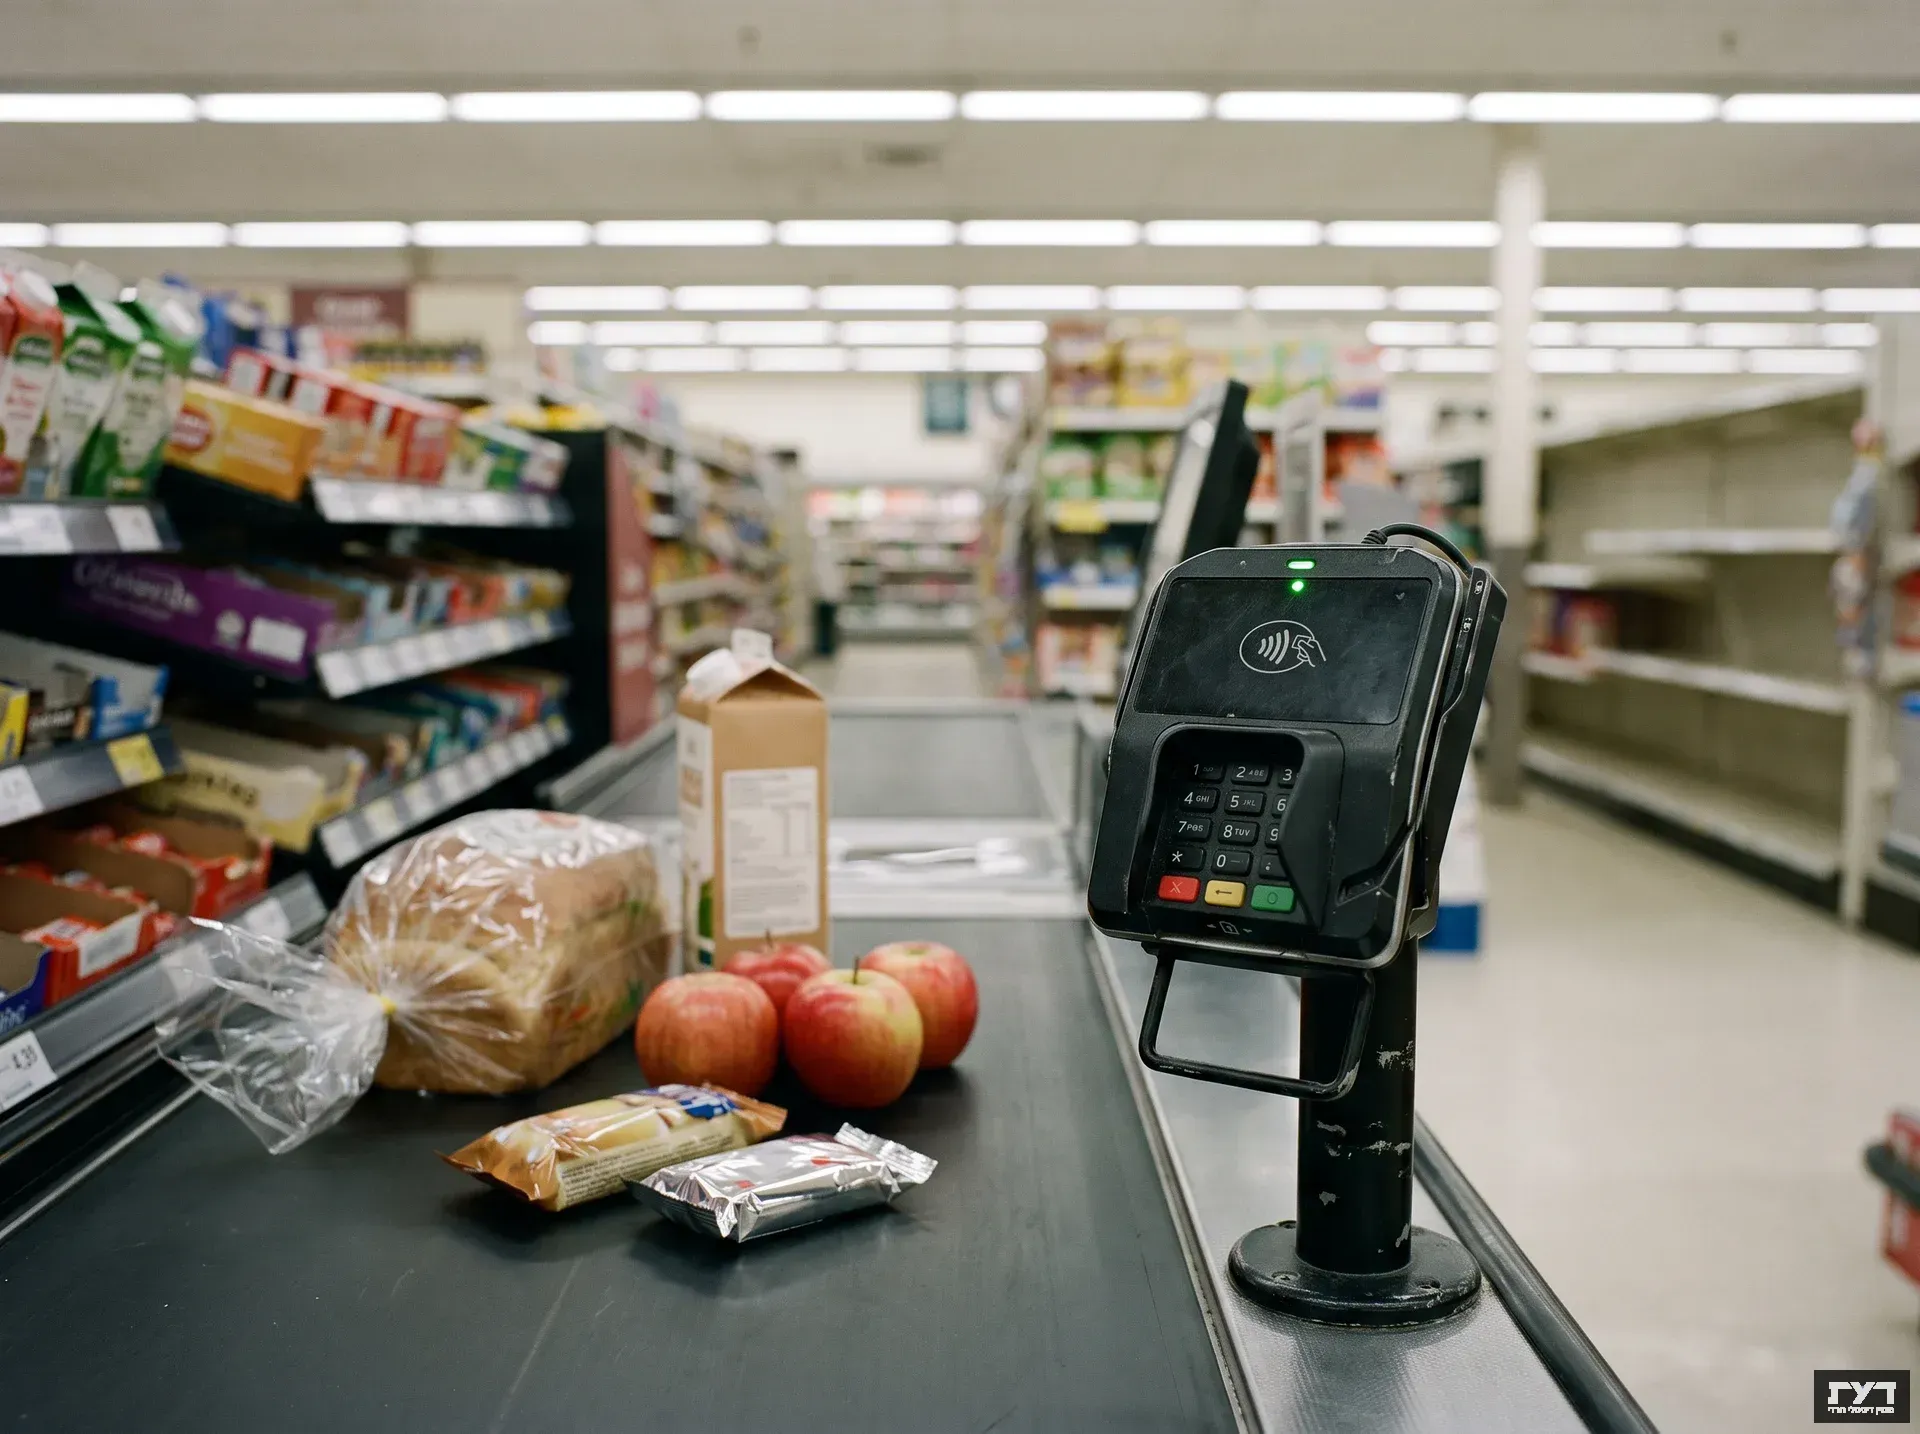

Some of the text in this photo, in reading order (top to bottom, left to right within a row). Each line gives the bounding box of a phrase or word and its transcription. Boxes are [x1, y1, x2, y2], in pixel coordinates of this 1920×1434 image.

[1193, 763, 1200, 776] 1
[1236, 766, 1247, 778] 2
[1282, 768, 1293, 781] 3
[1184, 791, 1210, 805] 4 GHI
[1230, 795, 1240, 808] 5
[1276, 798, 1287, 811] 6
[1178, 820, 1188, 833] 7
[1223, 824, 1233, 838] 8
[1270, 828, 1279, 841] 9
[1216, 854, 1227, 868] 0
